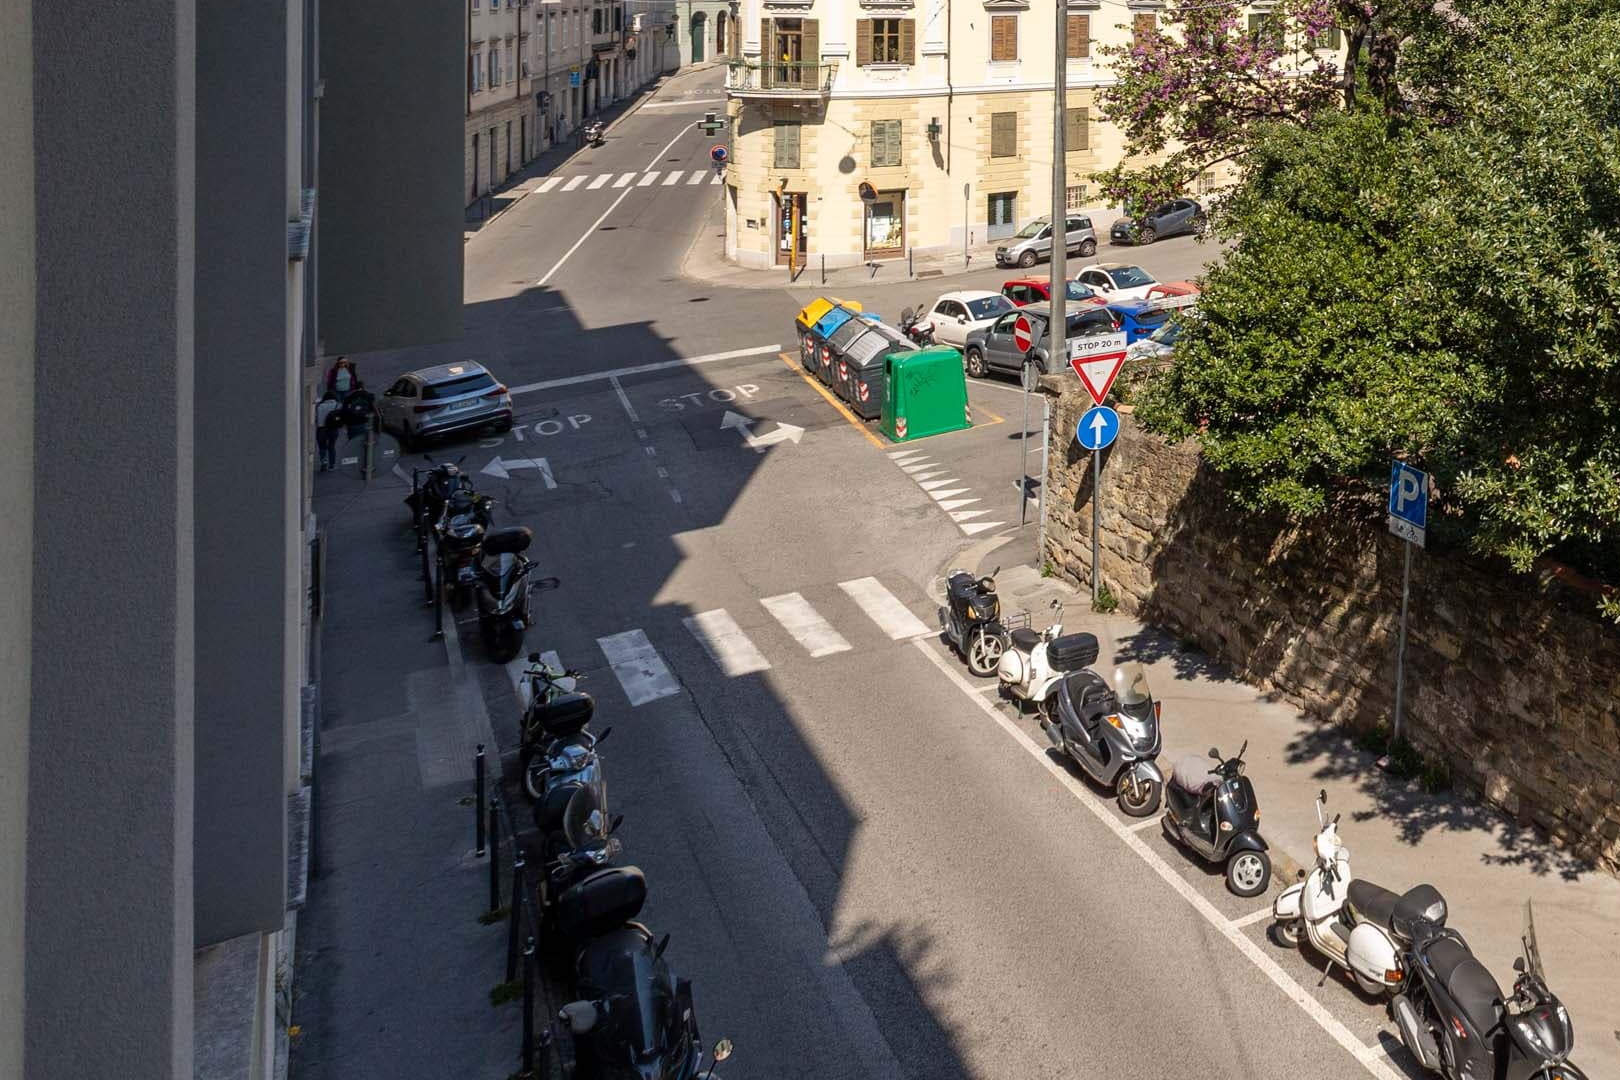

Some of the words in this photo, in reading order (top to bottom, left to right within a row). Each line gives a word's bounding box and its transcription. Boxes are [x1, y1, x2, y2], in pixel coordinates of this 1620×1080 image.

[1077, 342, 1099, 351] STOP
[1101, 340, 1112, 348] 20
[656, 383, 760, 410] STOP
[1397, 469, 1419, 512] P
